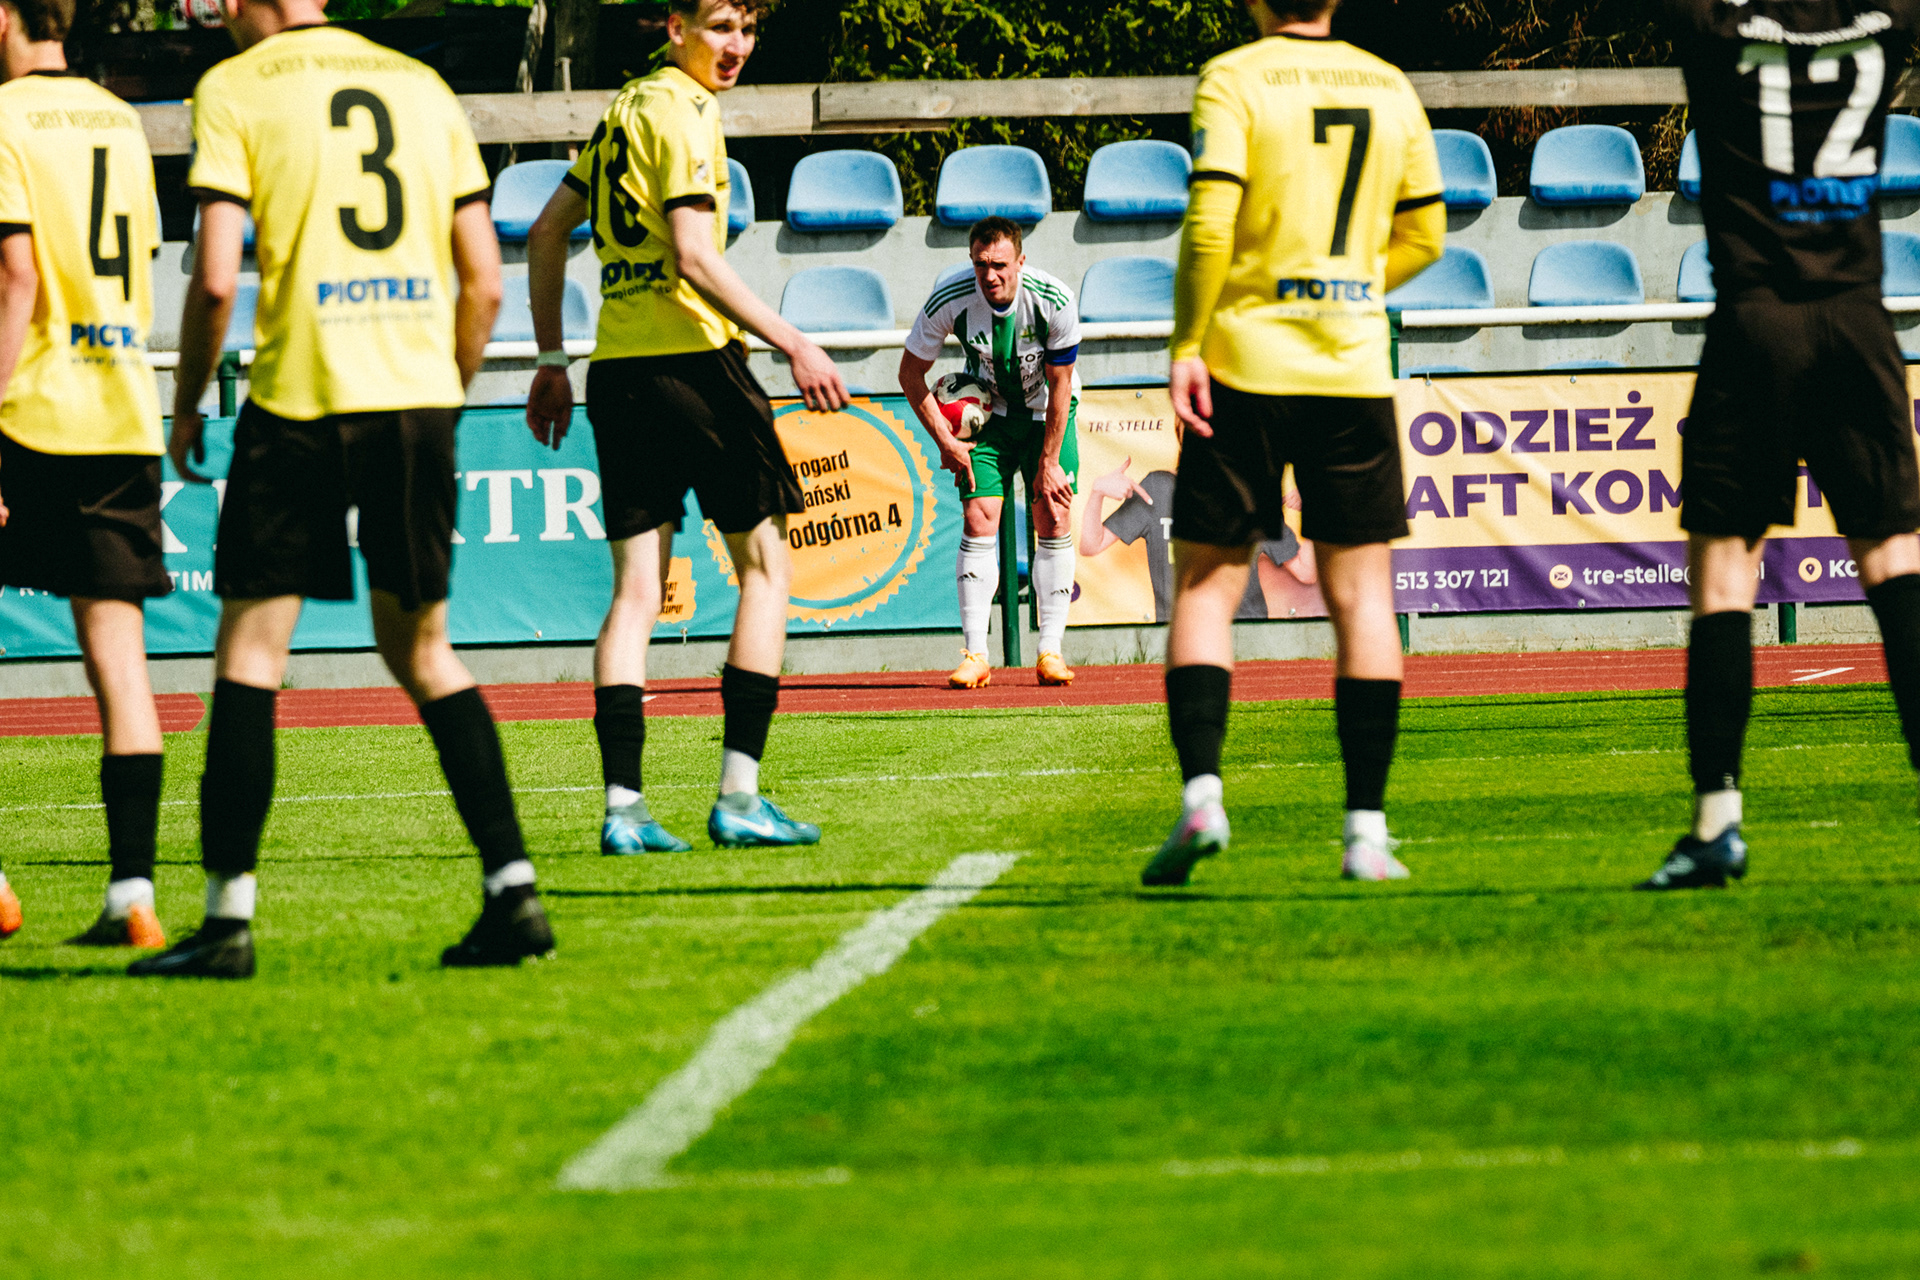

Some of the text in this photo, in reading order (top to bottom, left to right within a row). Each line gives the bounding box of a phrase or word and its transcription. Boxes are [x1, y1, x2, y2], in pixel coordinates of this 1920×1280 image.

[1736, 40, 1885, 178] 12
[331, 88, 404, 251] 3
[1314, 108, 1371, 256] 7
[89, 146, 129, 302] 4
[1409, 391, 1656, 456] ODZIEŻ
[791, 450, 849, 479] rogard
[804, 479, 851, 508] ański
[1550, 469, 1684, 517] KOM
[788, 502, 902, 550] odgórna 4
[1395, 571, 1429, 590] 513
[1434, 569, 1475, 589] 307
[1480, 567, 1509, 588] 121
